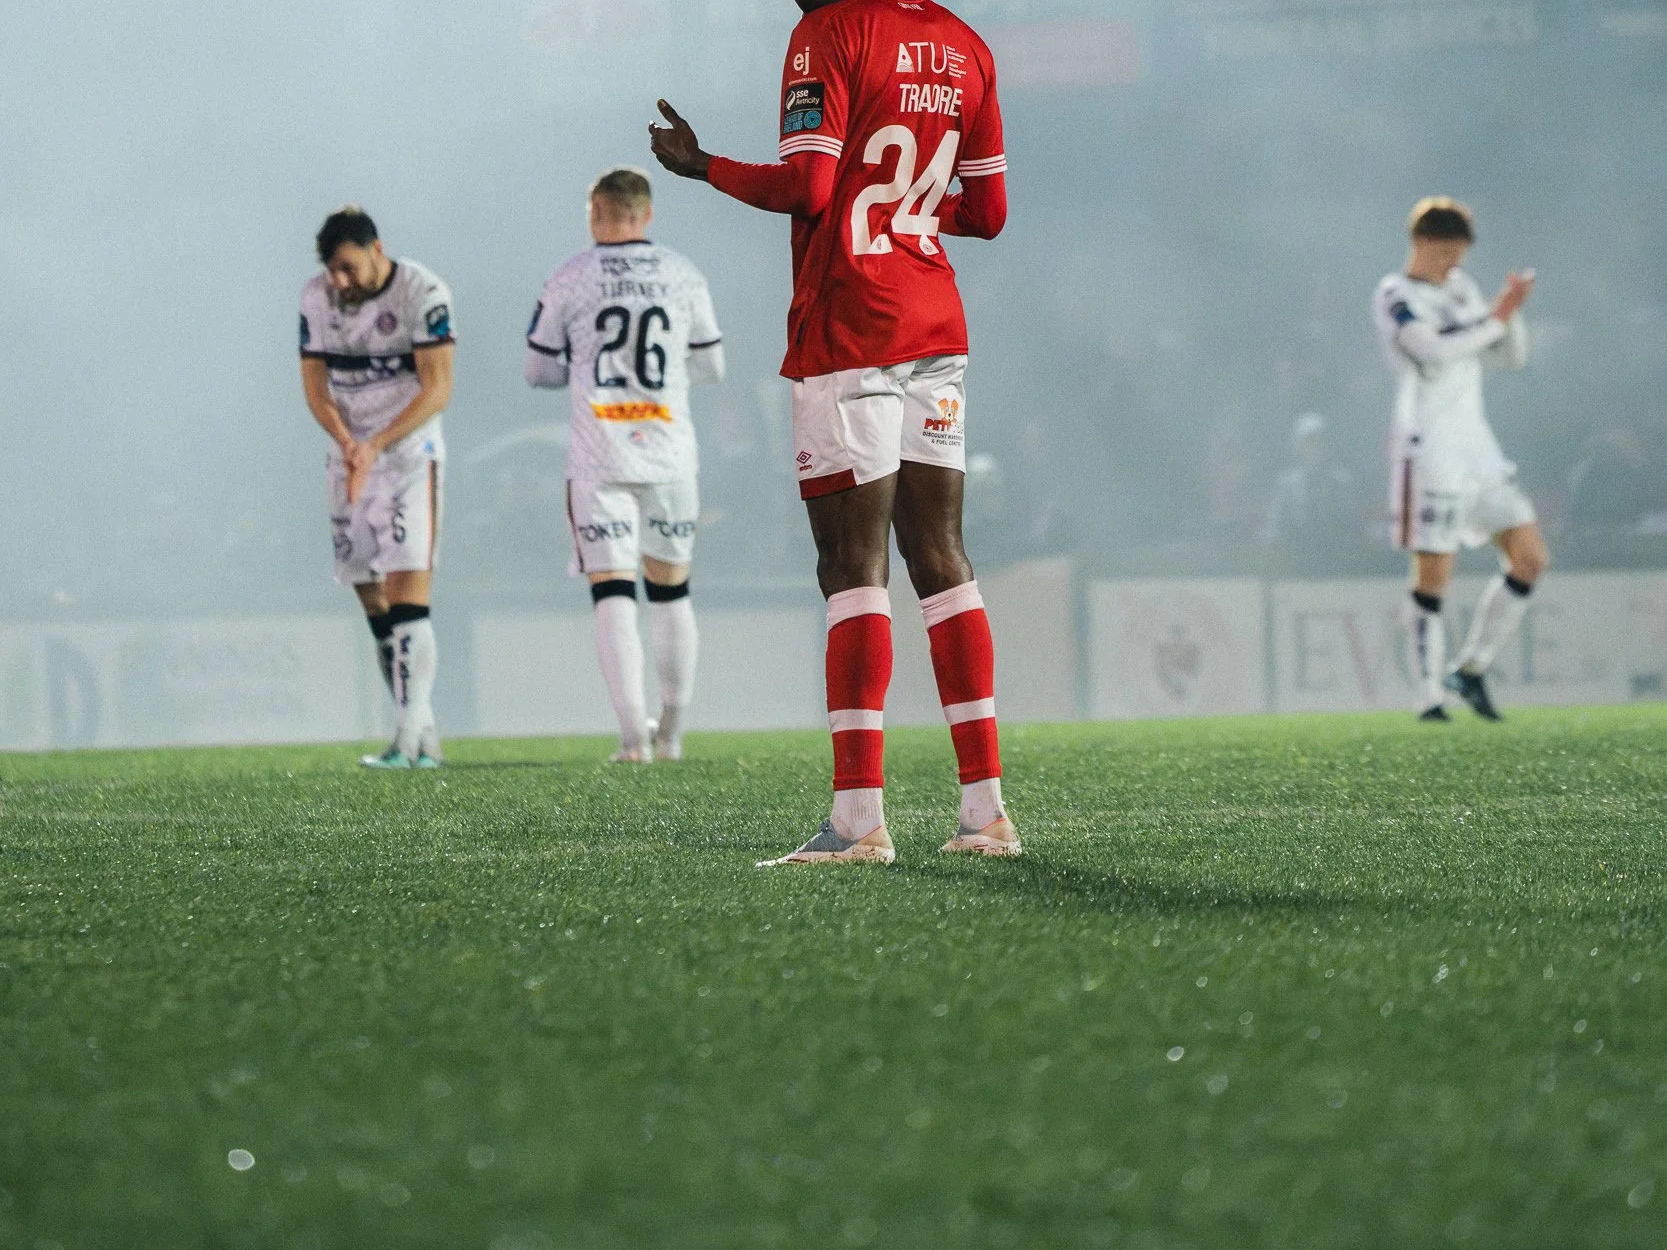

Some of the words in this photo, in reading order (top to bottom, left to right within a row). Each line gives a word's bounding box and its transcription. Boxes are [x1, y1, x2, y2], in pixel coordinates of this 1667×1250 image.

[793, 46, 810, 76] ej
[896, 42, 947, 74] ATU
[795, 97, 820, 106] Airtricity
[796, 89, 809, 98] sse
[899, 83, 963, 117] TRAORE
[851, 124, 960, 255] 24
[595, 305, 670, 390] 26
